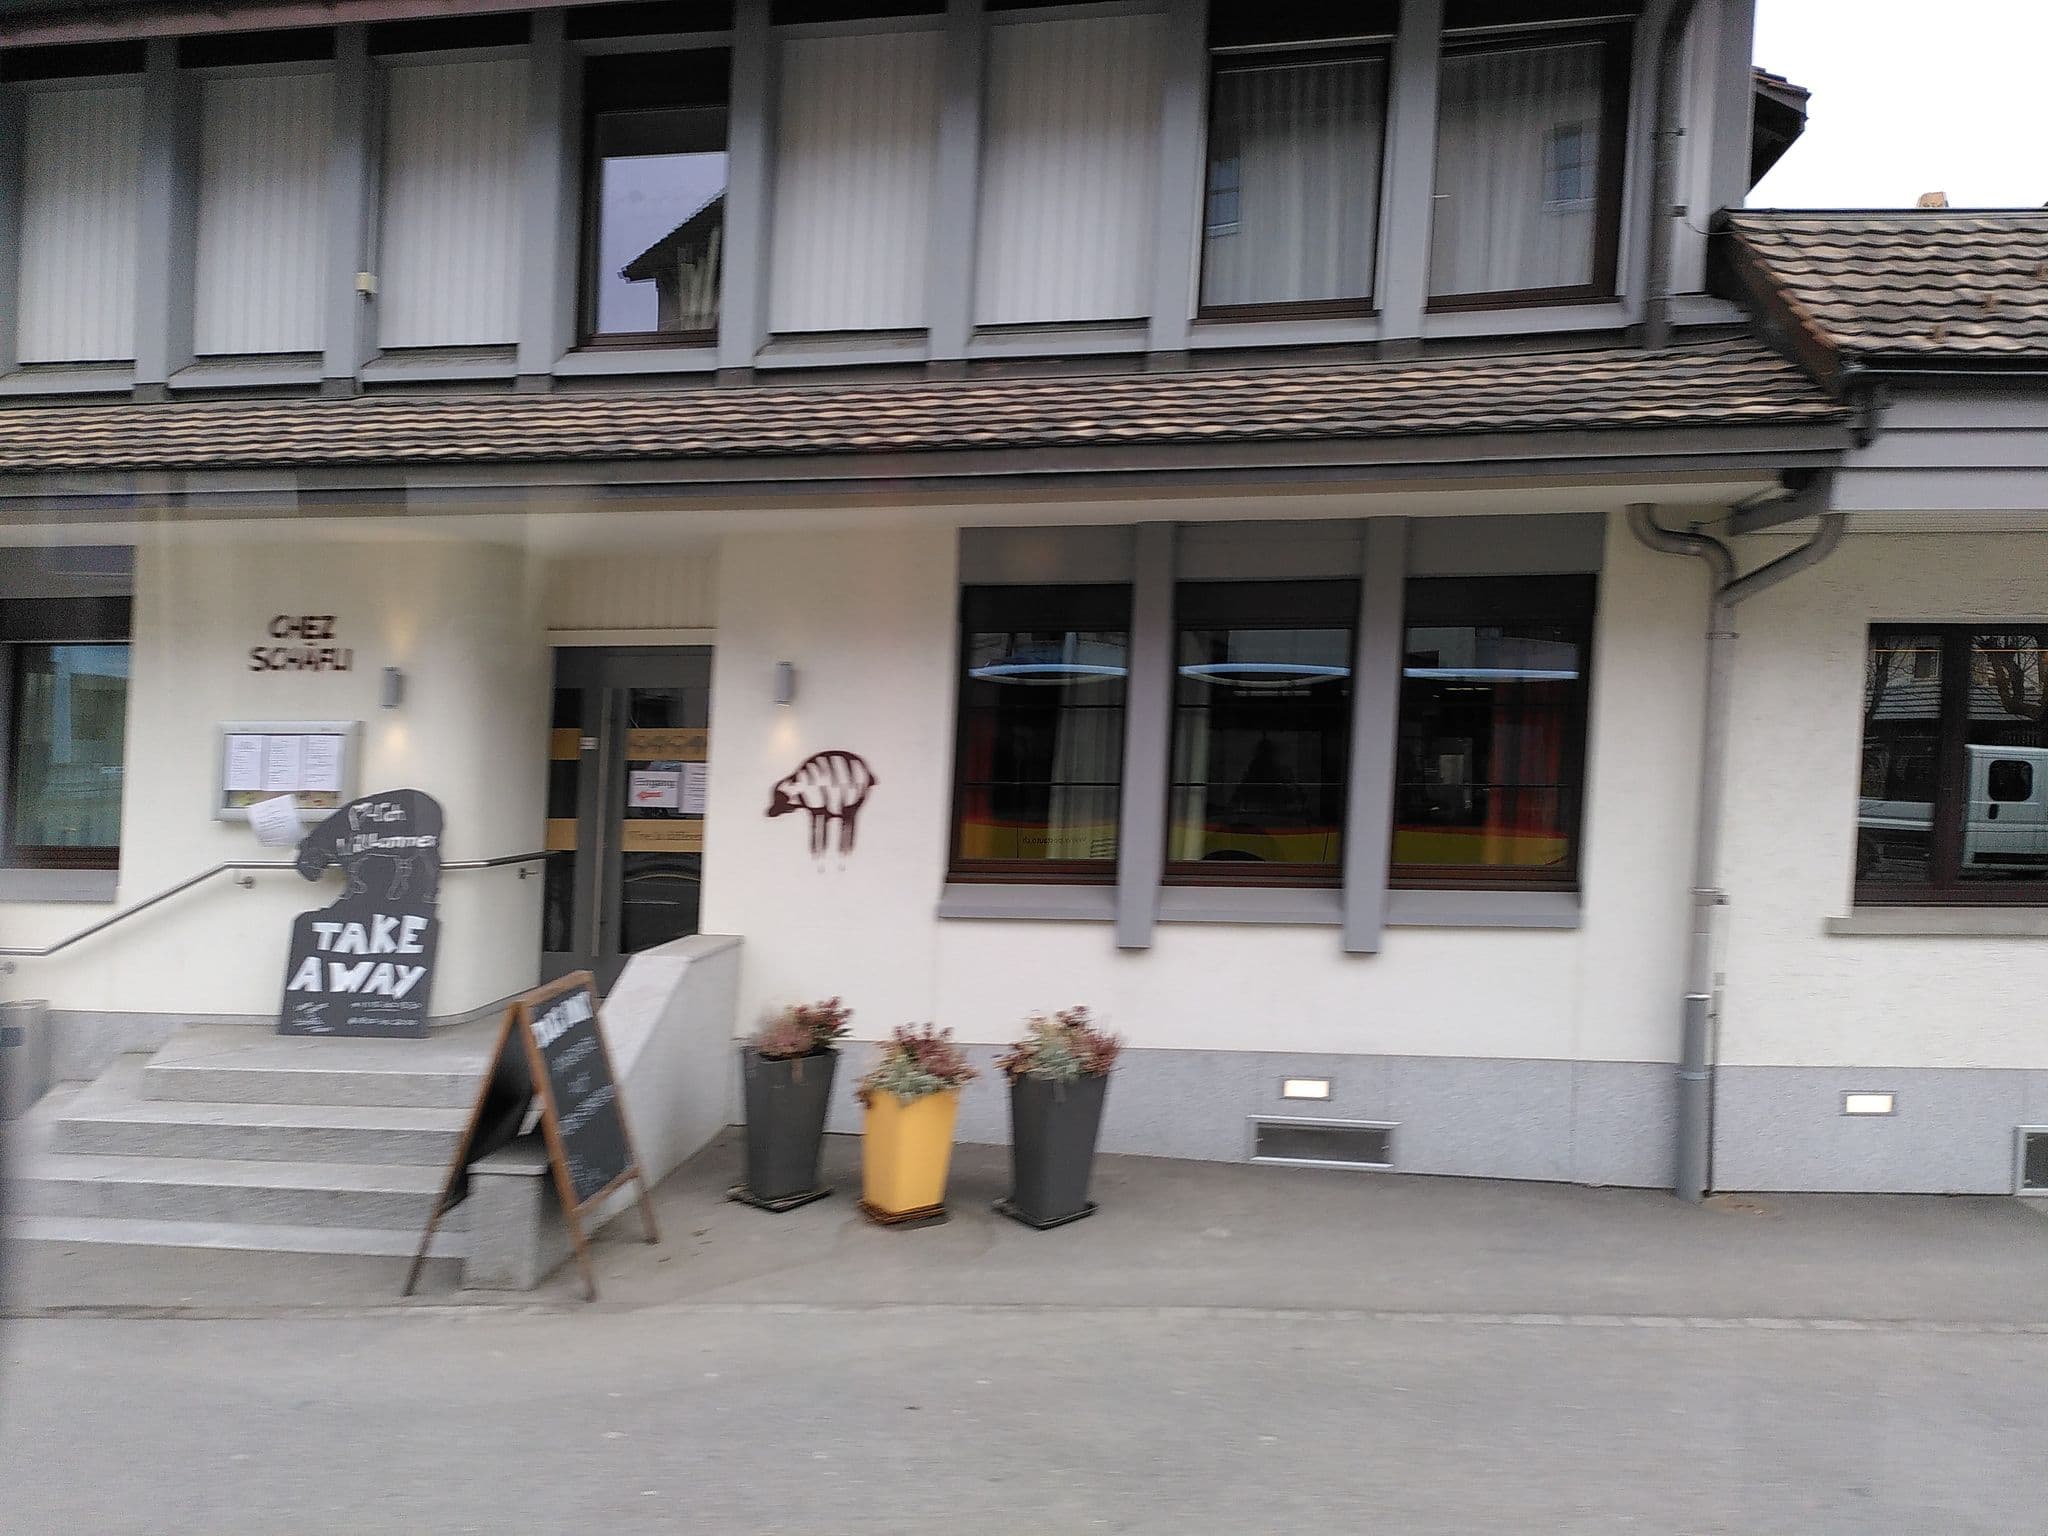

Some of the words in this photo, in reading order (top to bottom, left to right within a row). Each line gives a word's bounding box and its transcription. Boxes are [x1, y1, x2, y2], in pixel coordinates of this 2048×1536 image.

[269, 614, 336, 639] CHEZ
[311, 913, 429, 955] TAKE
[286, 956, 428, 1000] AWAY
